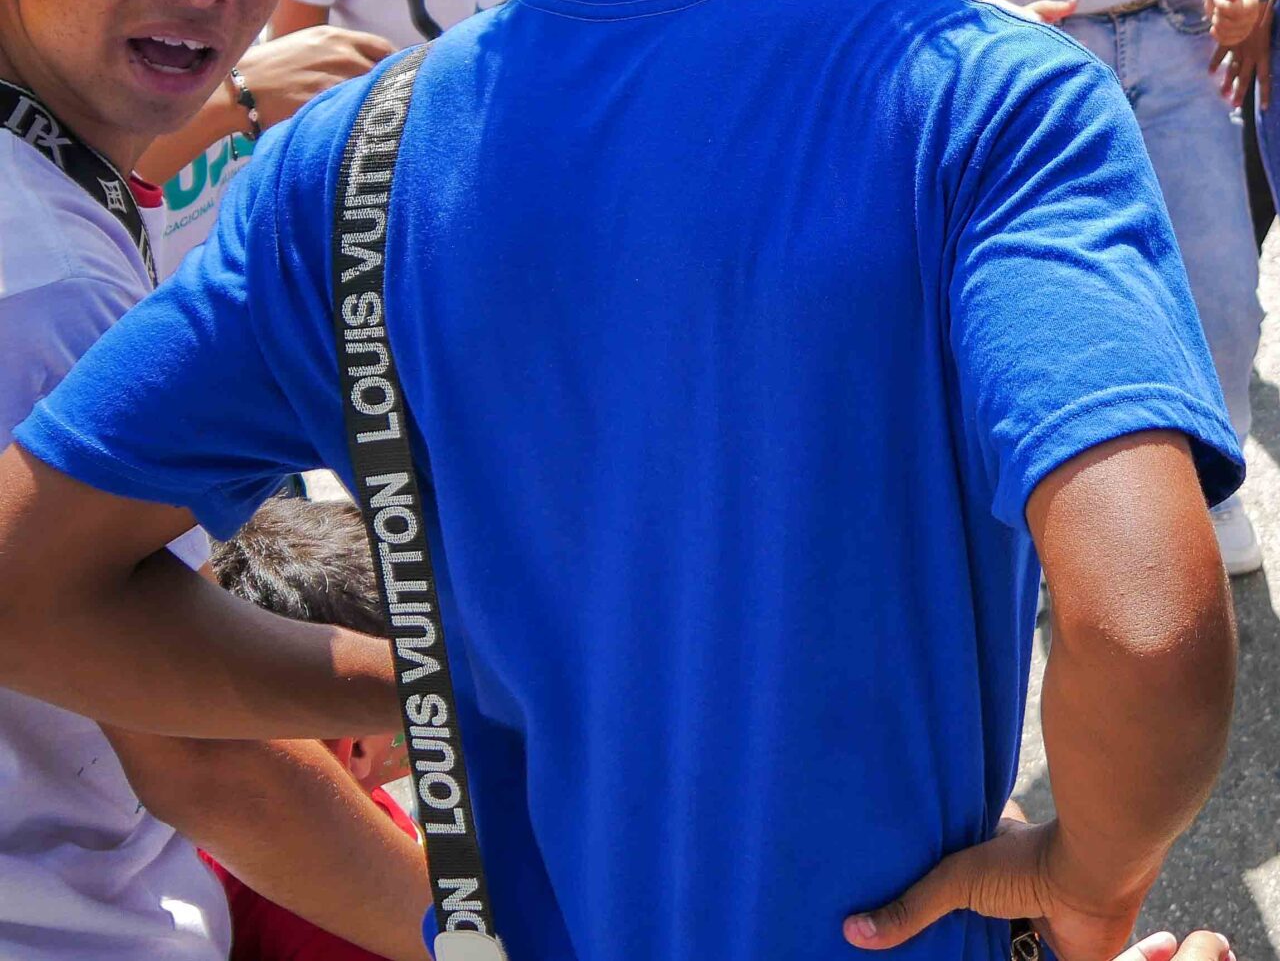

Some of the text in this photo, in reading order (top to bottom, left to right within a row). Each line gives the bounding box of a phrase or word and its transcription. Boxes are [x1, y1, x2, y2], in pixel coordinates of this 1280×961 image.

[340, 67, 418, 445] LOUIS VUITTON
[365, 470, 467, 836] LOUIS VUITTON
